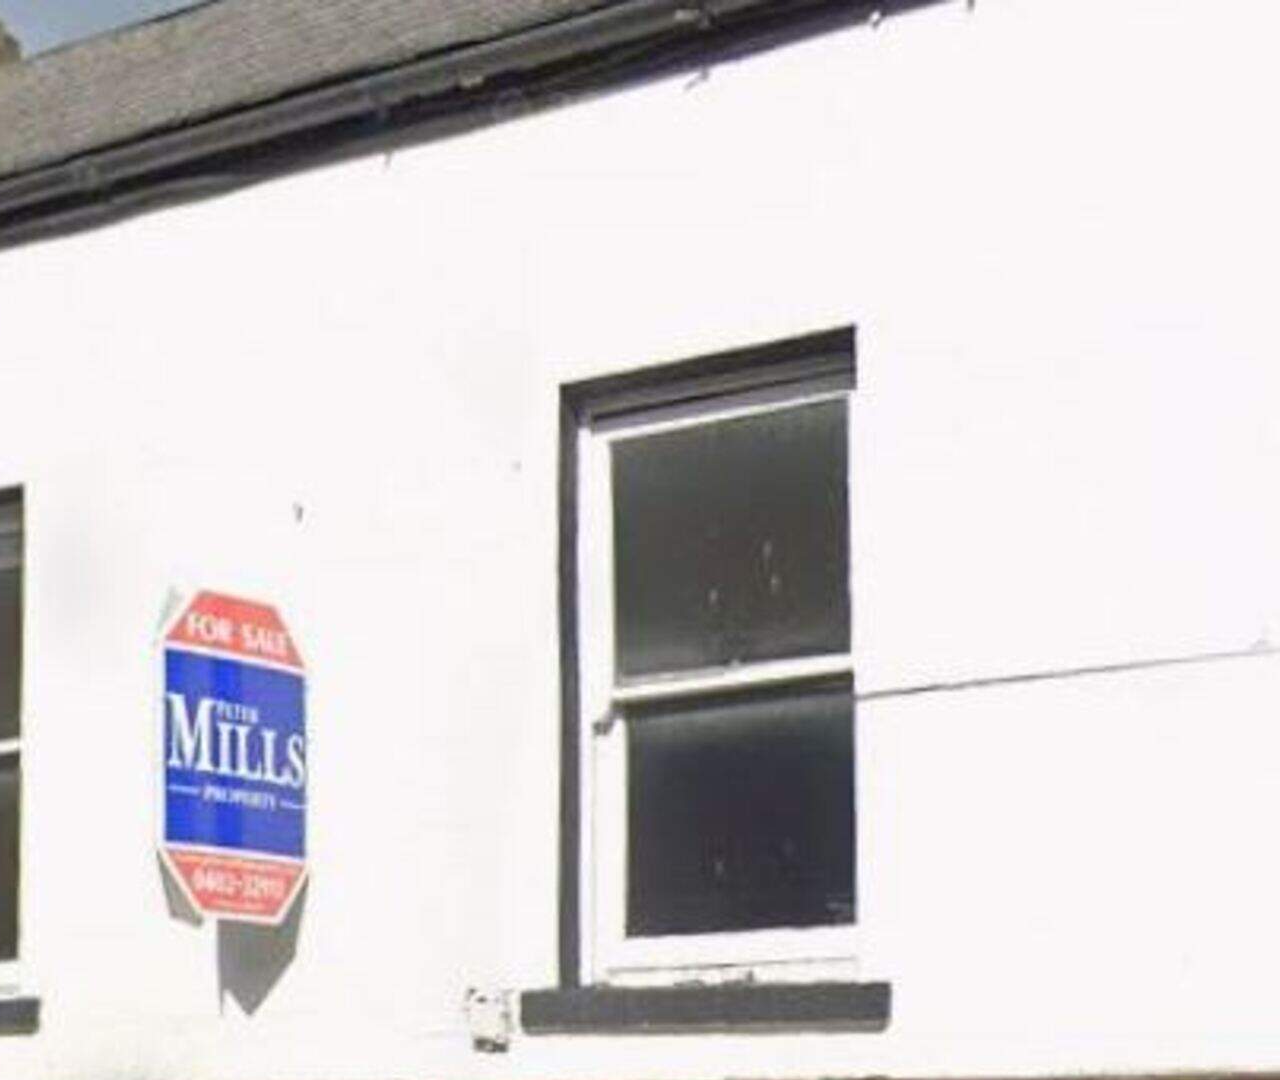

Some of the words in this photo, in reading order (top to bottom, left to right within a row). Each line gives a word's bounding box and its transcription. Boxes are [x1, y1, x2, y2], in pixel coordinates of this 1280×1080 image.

[187, 612, 233, 641] FOR
[241, 623, 289, 656] SALE
[166, 690, 306, 790] MILLS
